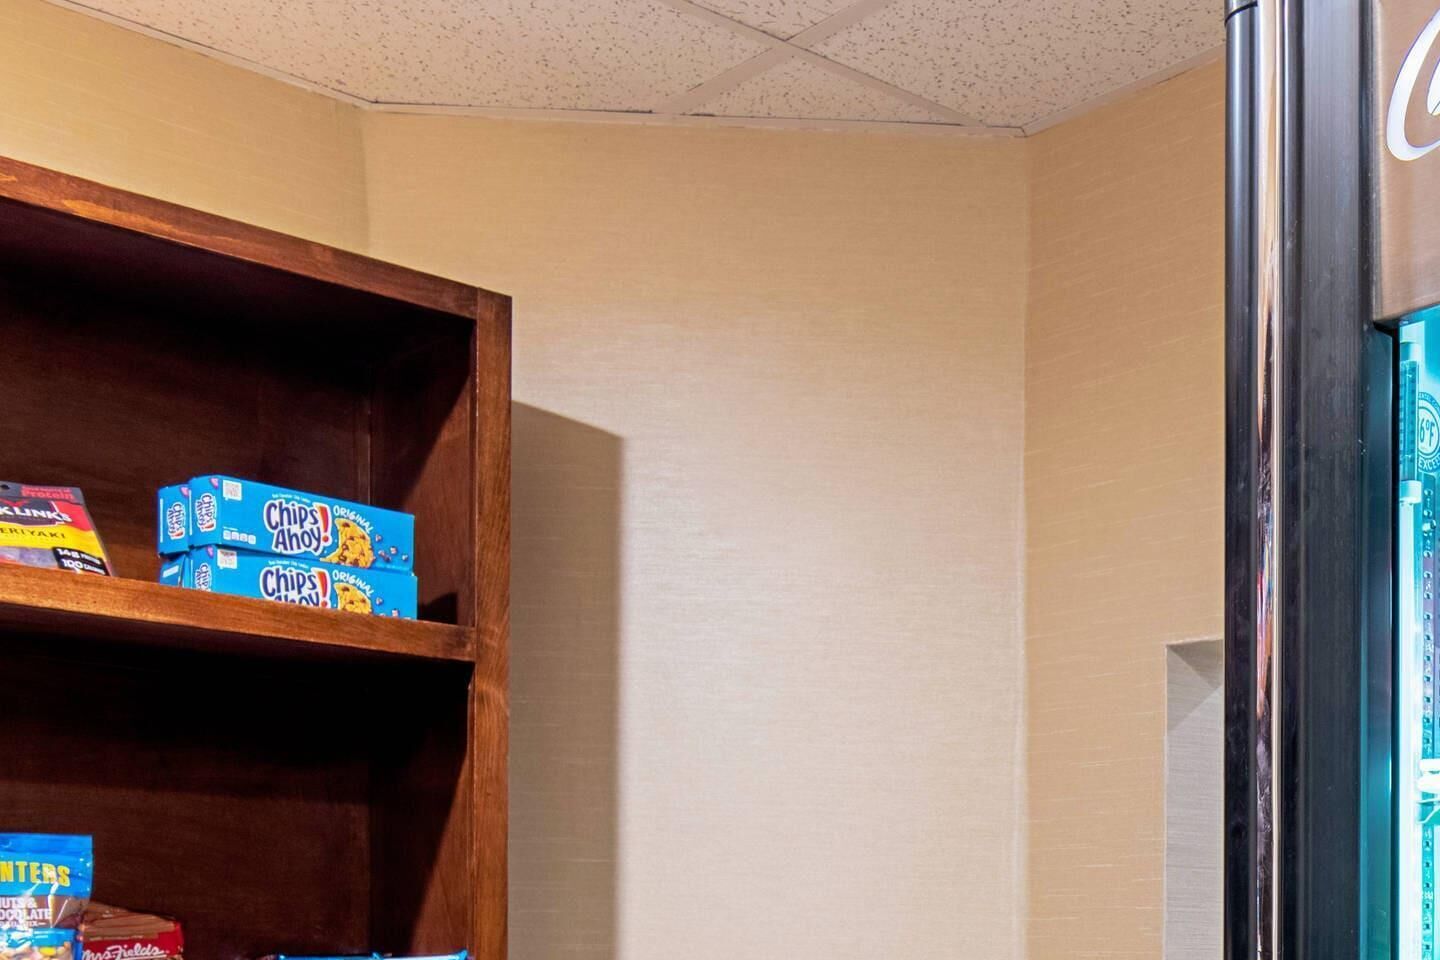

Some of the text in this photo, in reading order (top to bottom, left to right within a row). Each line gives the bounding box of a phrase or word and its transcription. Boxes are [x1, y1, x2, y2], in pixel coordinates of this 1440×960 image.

[265, 500, 319, 531] Chips
[333, 505, 374, 533] ORIGINAL
[262, 568, 317, 598] Chips
[333, 570, 374, 597] ORIGINAL
